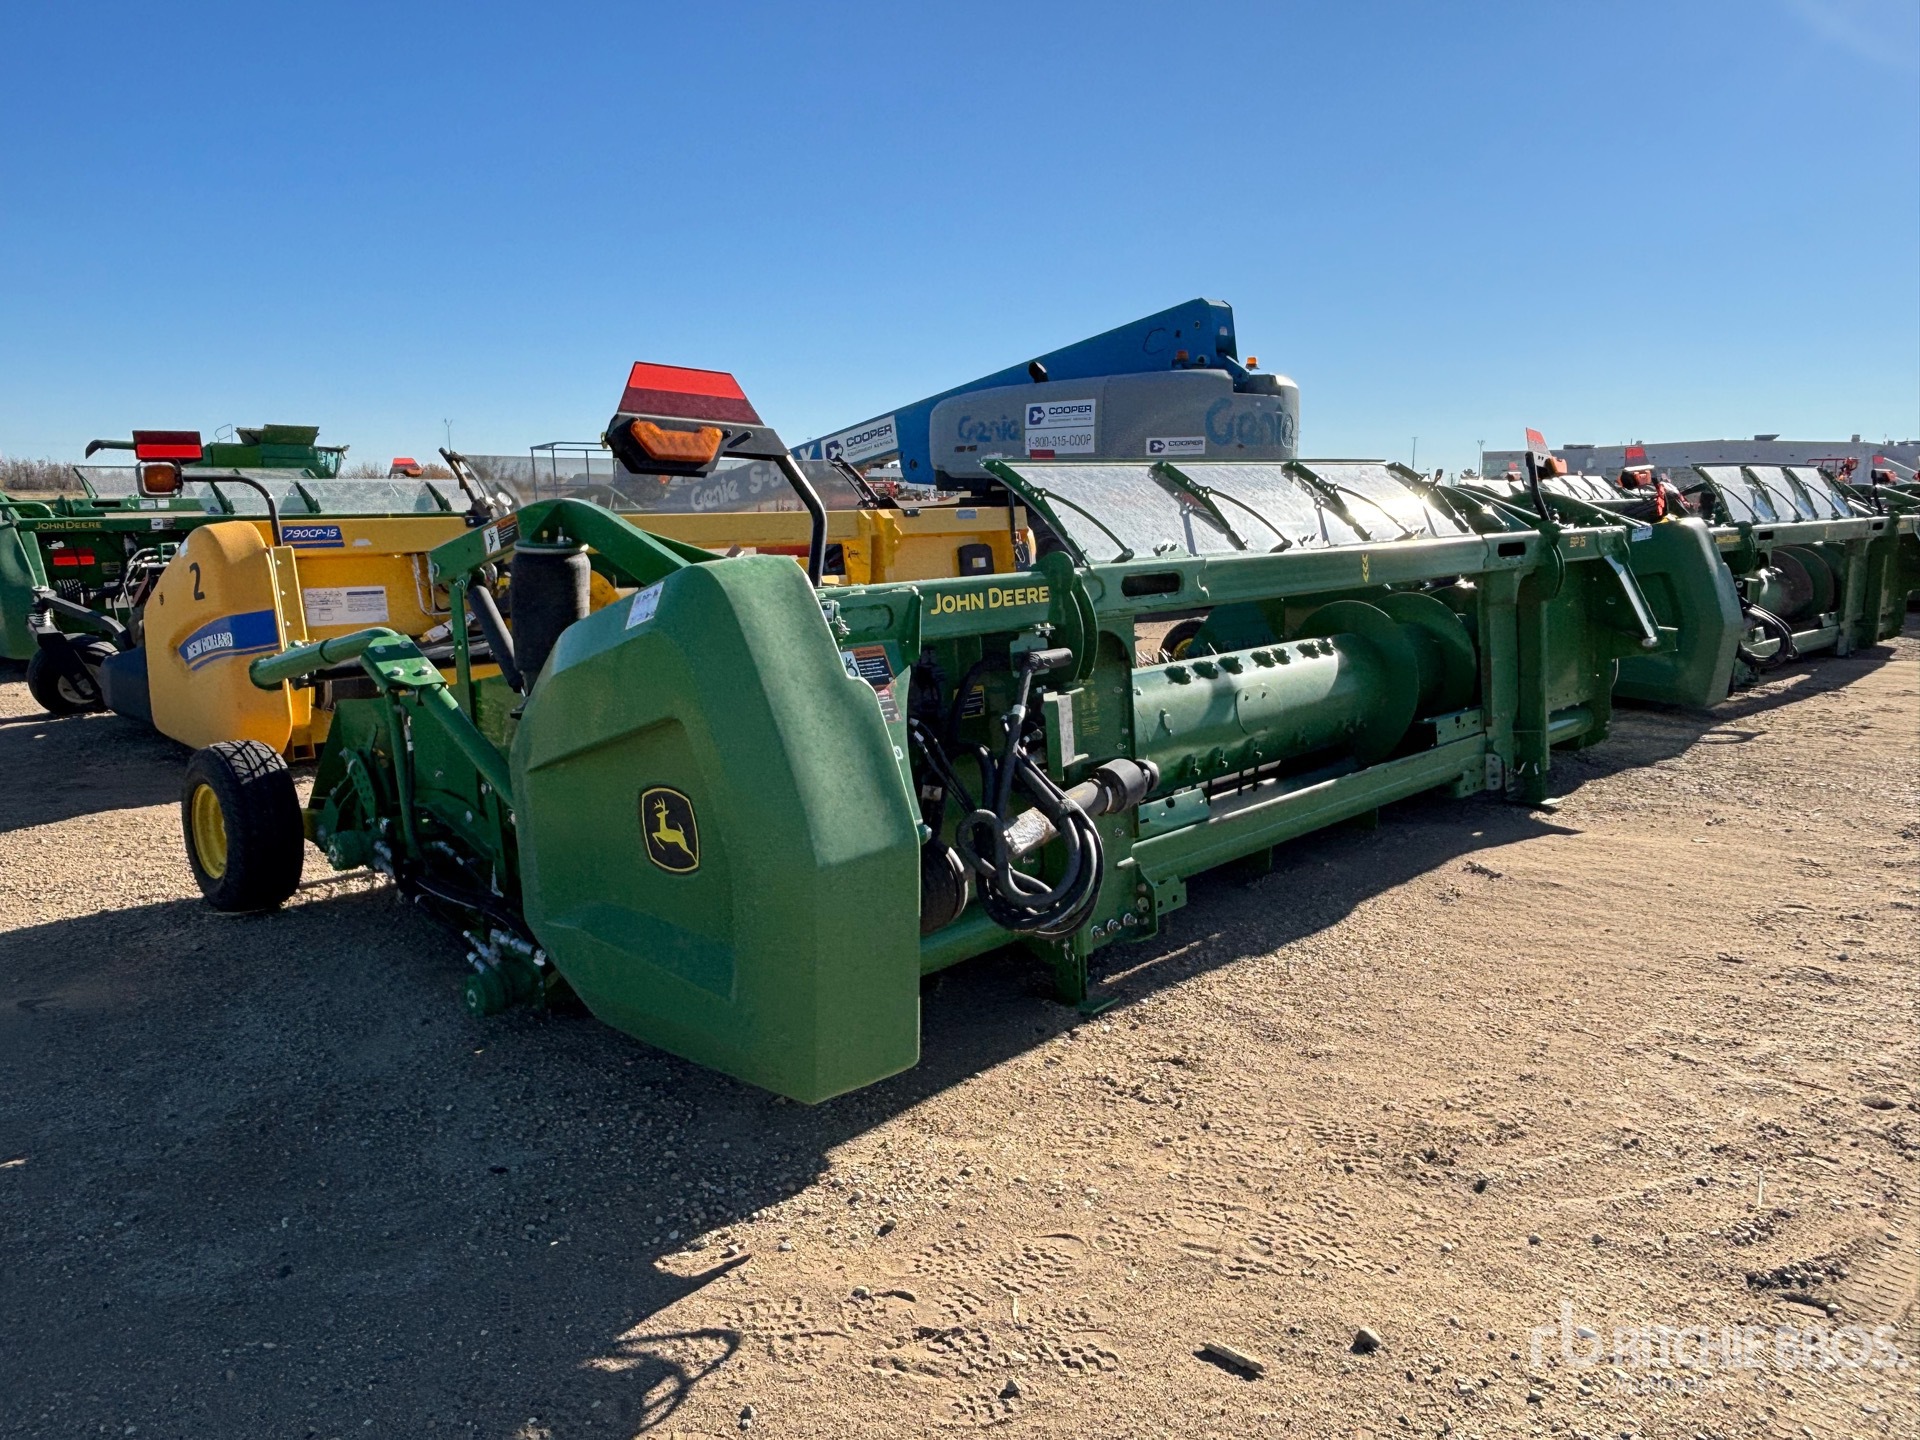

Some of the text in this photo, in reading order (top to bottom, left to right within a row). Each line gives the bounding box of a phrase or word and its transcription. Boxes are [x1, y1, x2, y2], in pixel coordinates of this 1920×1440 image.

[1048, 405, 1092, 415] COOPER
[846, 423, 893, 447] COOPER
[1168, 439, 1204, 447] COOPER
[690, 476, 740, 511] Genie
[35, 521, 102, 530] JOHN DEERE
[284, 528, 338, 539] 790CP-15
[189, 562, 206, 601] 2
[930, 586, 1050, 614] JOHN DEERE
